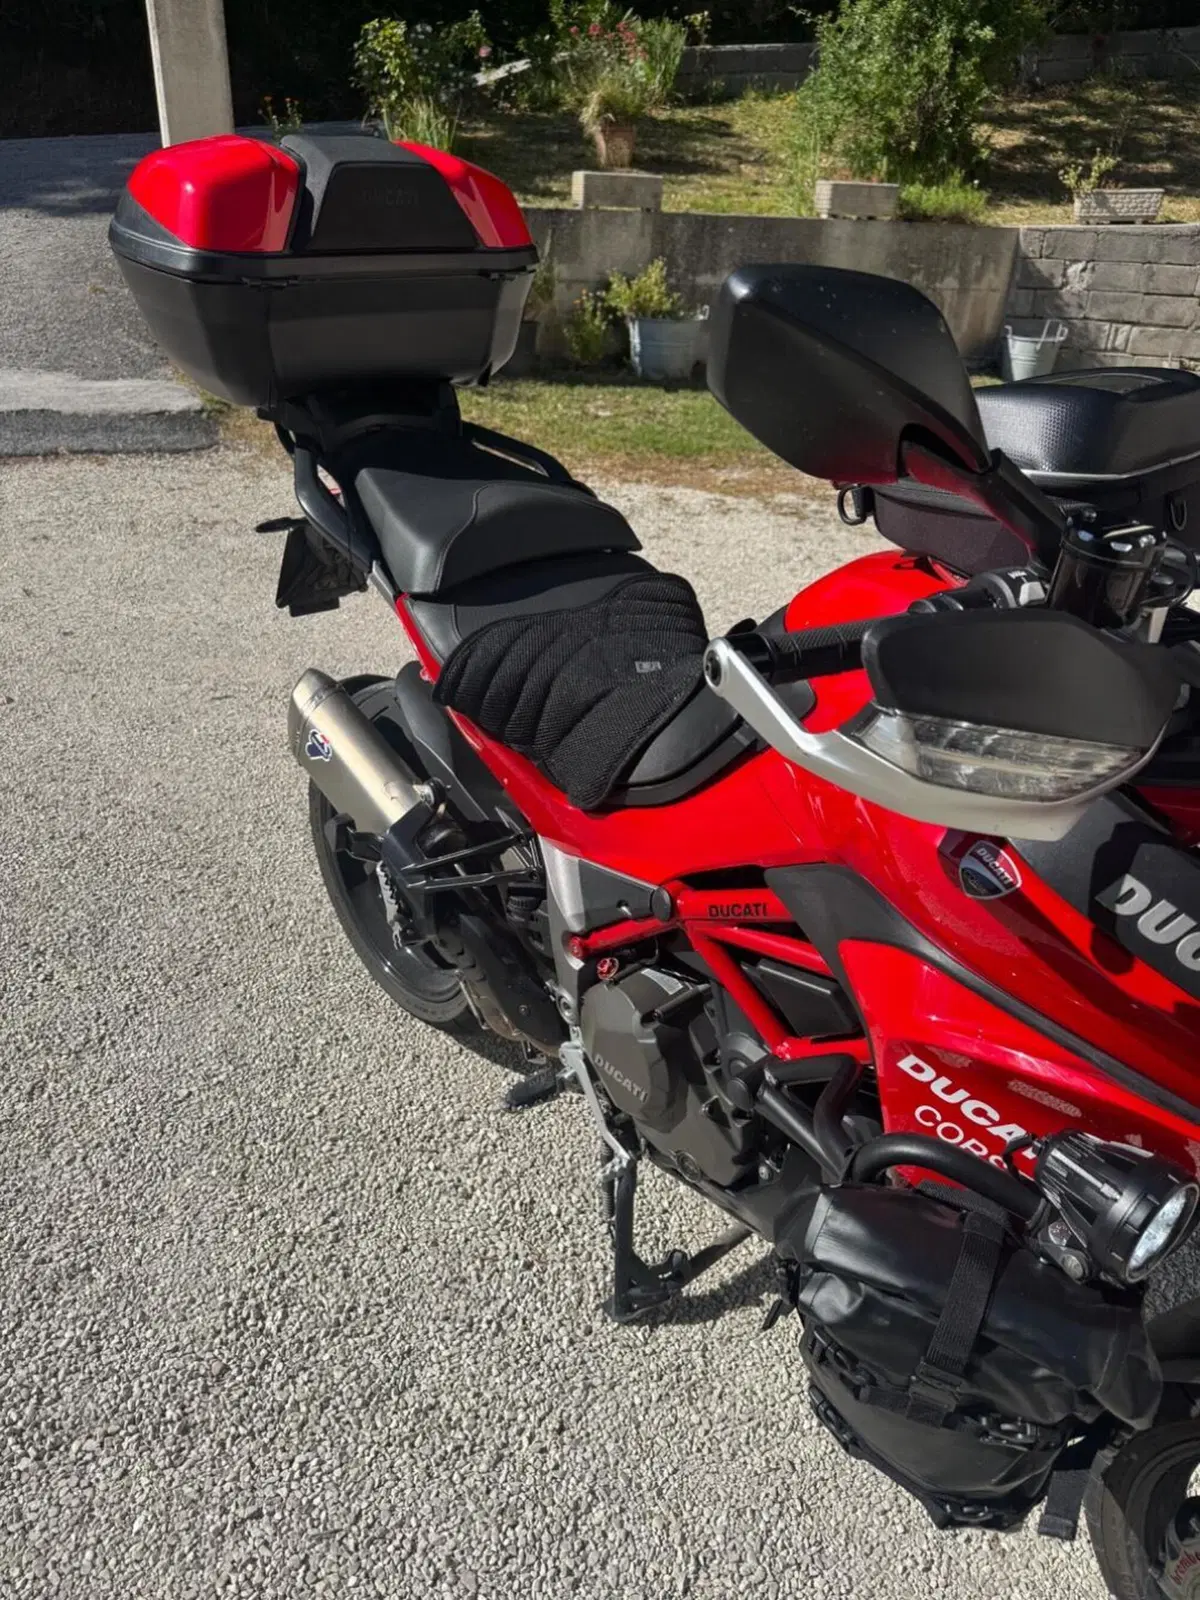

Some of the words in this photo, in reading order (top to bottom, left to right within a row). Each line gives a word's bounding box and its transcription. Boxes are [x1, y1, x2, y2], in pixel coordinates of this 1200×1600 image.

[976, 847, 1015, 885] DUCATI
[708, 902, 768, 918] DUCATI
[594, 1053, 648, 1104] DUCATI
[896, 1054, 1037, 1160] DUCA
